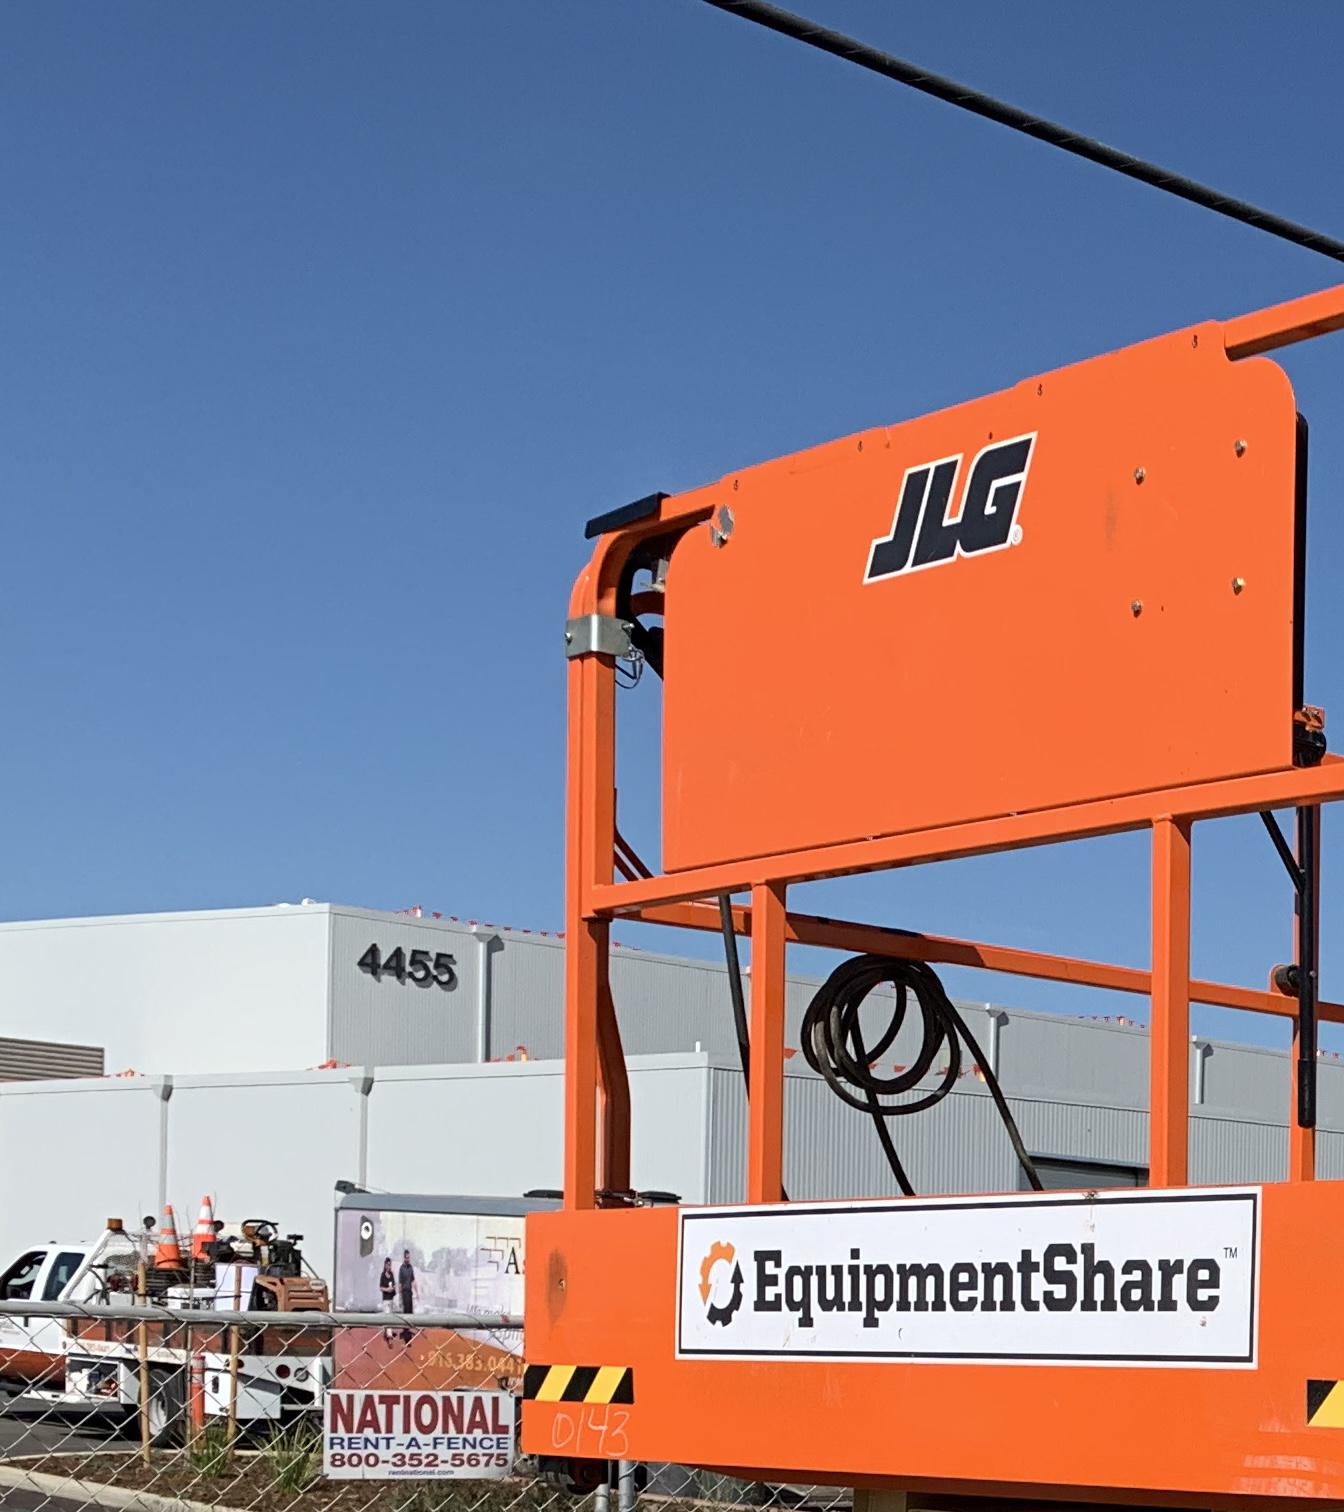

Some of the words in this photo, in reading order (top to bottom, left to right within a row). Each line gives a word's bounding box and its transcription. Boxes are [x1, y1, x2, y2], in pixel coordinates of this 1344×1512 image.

[864, 434, 1036, 583] JLG
[357, 943, 455, 986] 4455
[753, 1243, 1221, 1328] EquipmentShare
[330, 1394, 509, 1435] NATIONAL
[552, 1405, 630, 1457] 0143
[329, 1437, 509, 1450] RENT-A-FENCE
[330, 1453, 509, 1468] 800-352-5675
